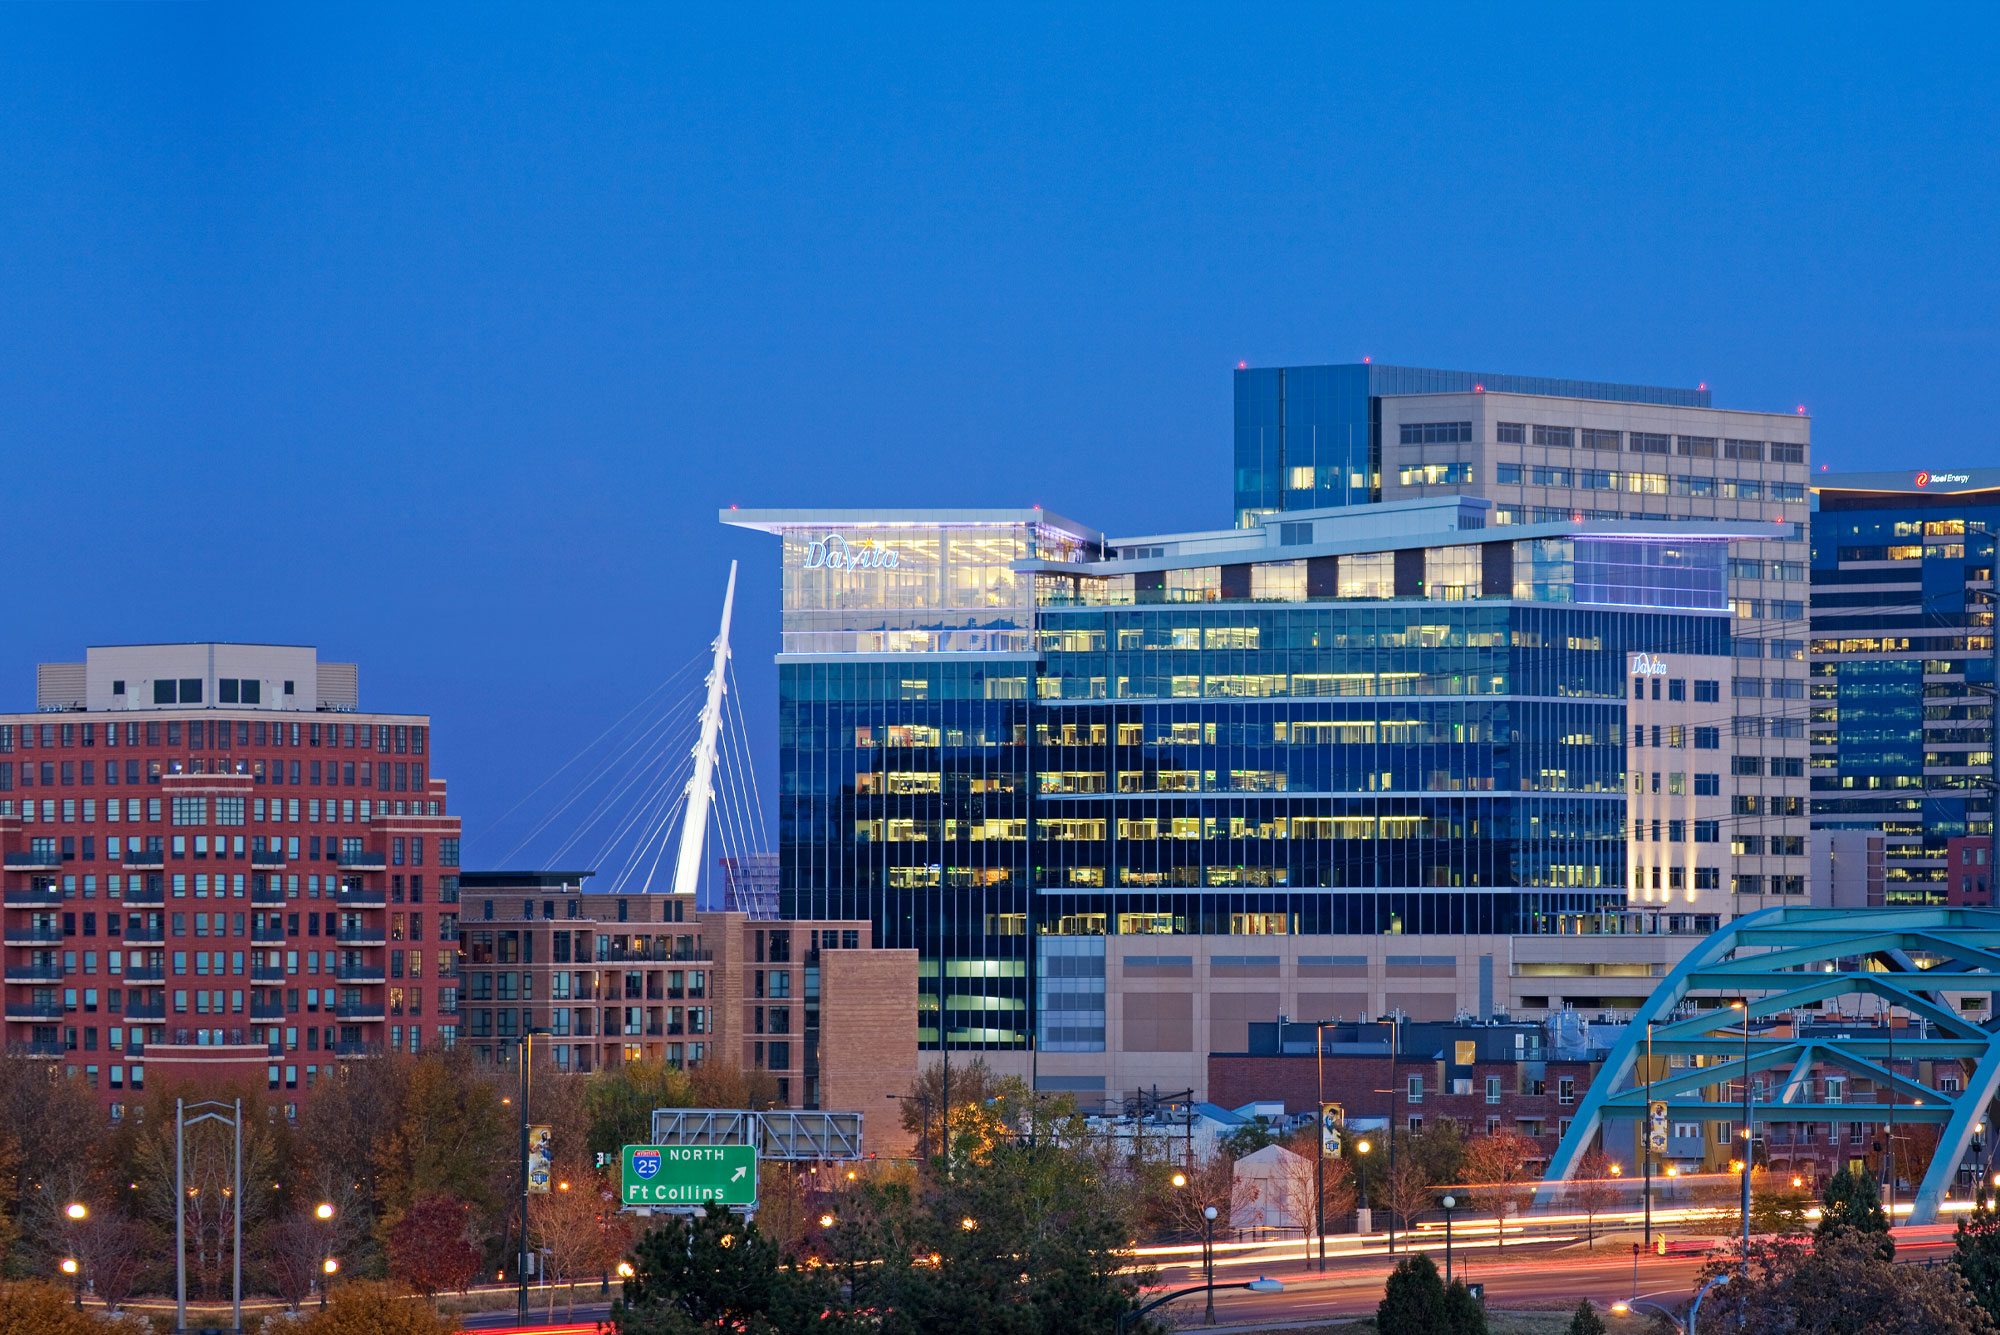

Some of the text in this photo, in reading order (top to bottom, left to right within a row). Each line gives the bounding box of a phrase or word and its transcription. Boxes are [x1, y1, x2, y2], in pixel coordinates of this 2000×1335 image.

[1947, 474, 1970, 484] Energy
[803, 534, 899, 574] DaVita
[1631, 652, 1667, 679] DaVita
[670, 1149, 724, 1160] NORTH
[638, 1160, 657, 1173] 25
[629, 1184, 724, 1200] Ft Collins
